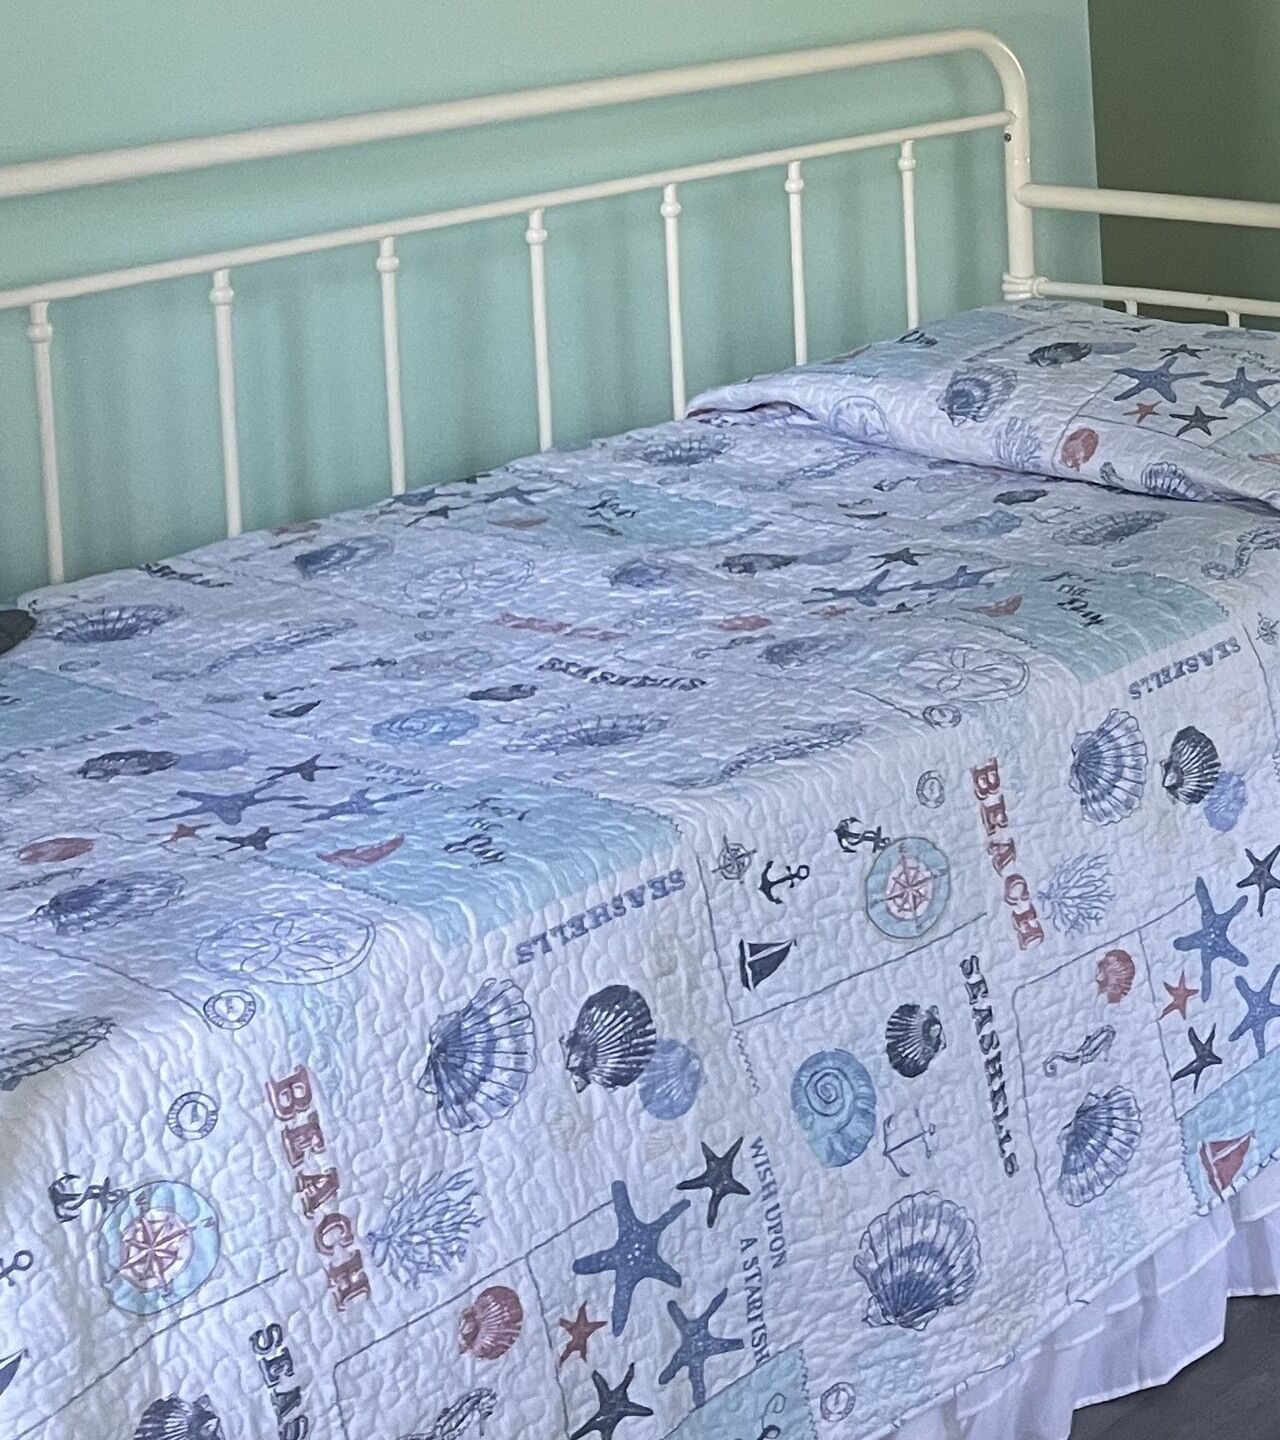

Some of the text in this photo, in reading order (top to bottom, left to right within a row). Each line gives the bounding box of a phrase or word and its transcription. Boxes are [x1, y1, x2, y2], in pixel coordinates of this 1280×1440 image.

[514, 866, 687, 966] SEASHELLS
[970, 756, 1046, 952] BEACH
[264, 1063, 372, 1313] BEACH
[750, 1135, 788, 1270] WISH UPON
